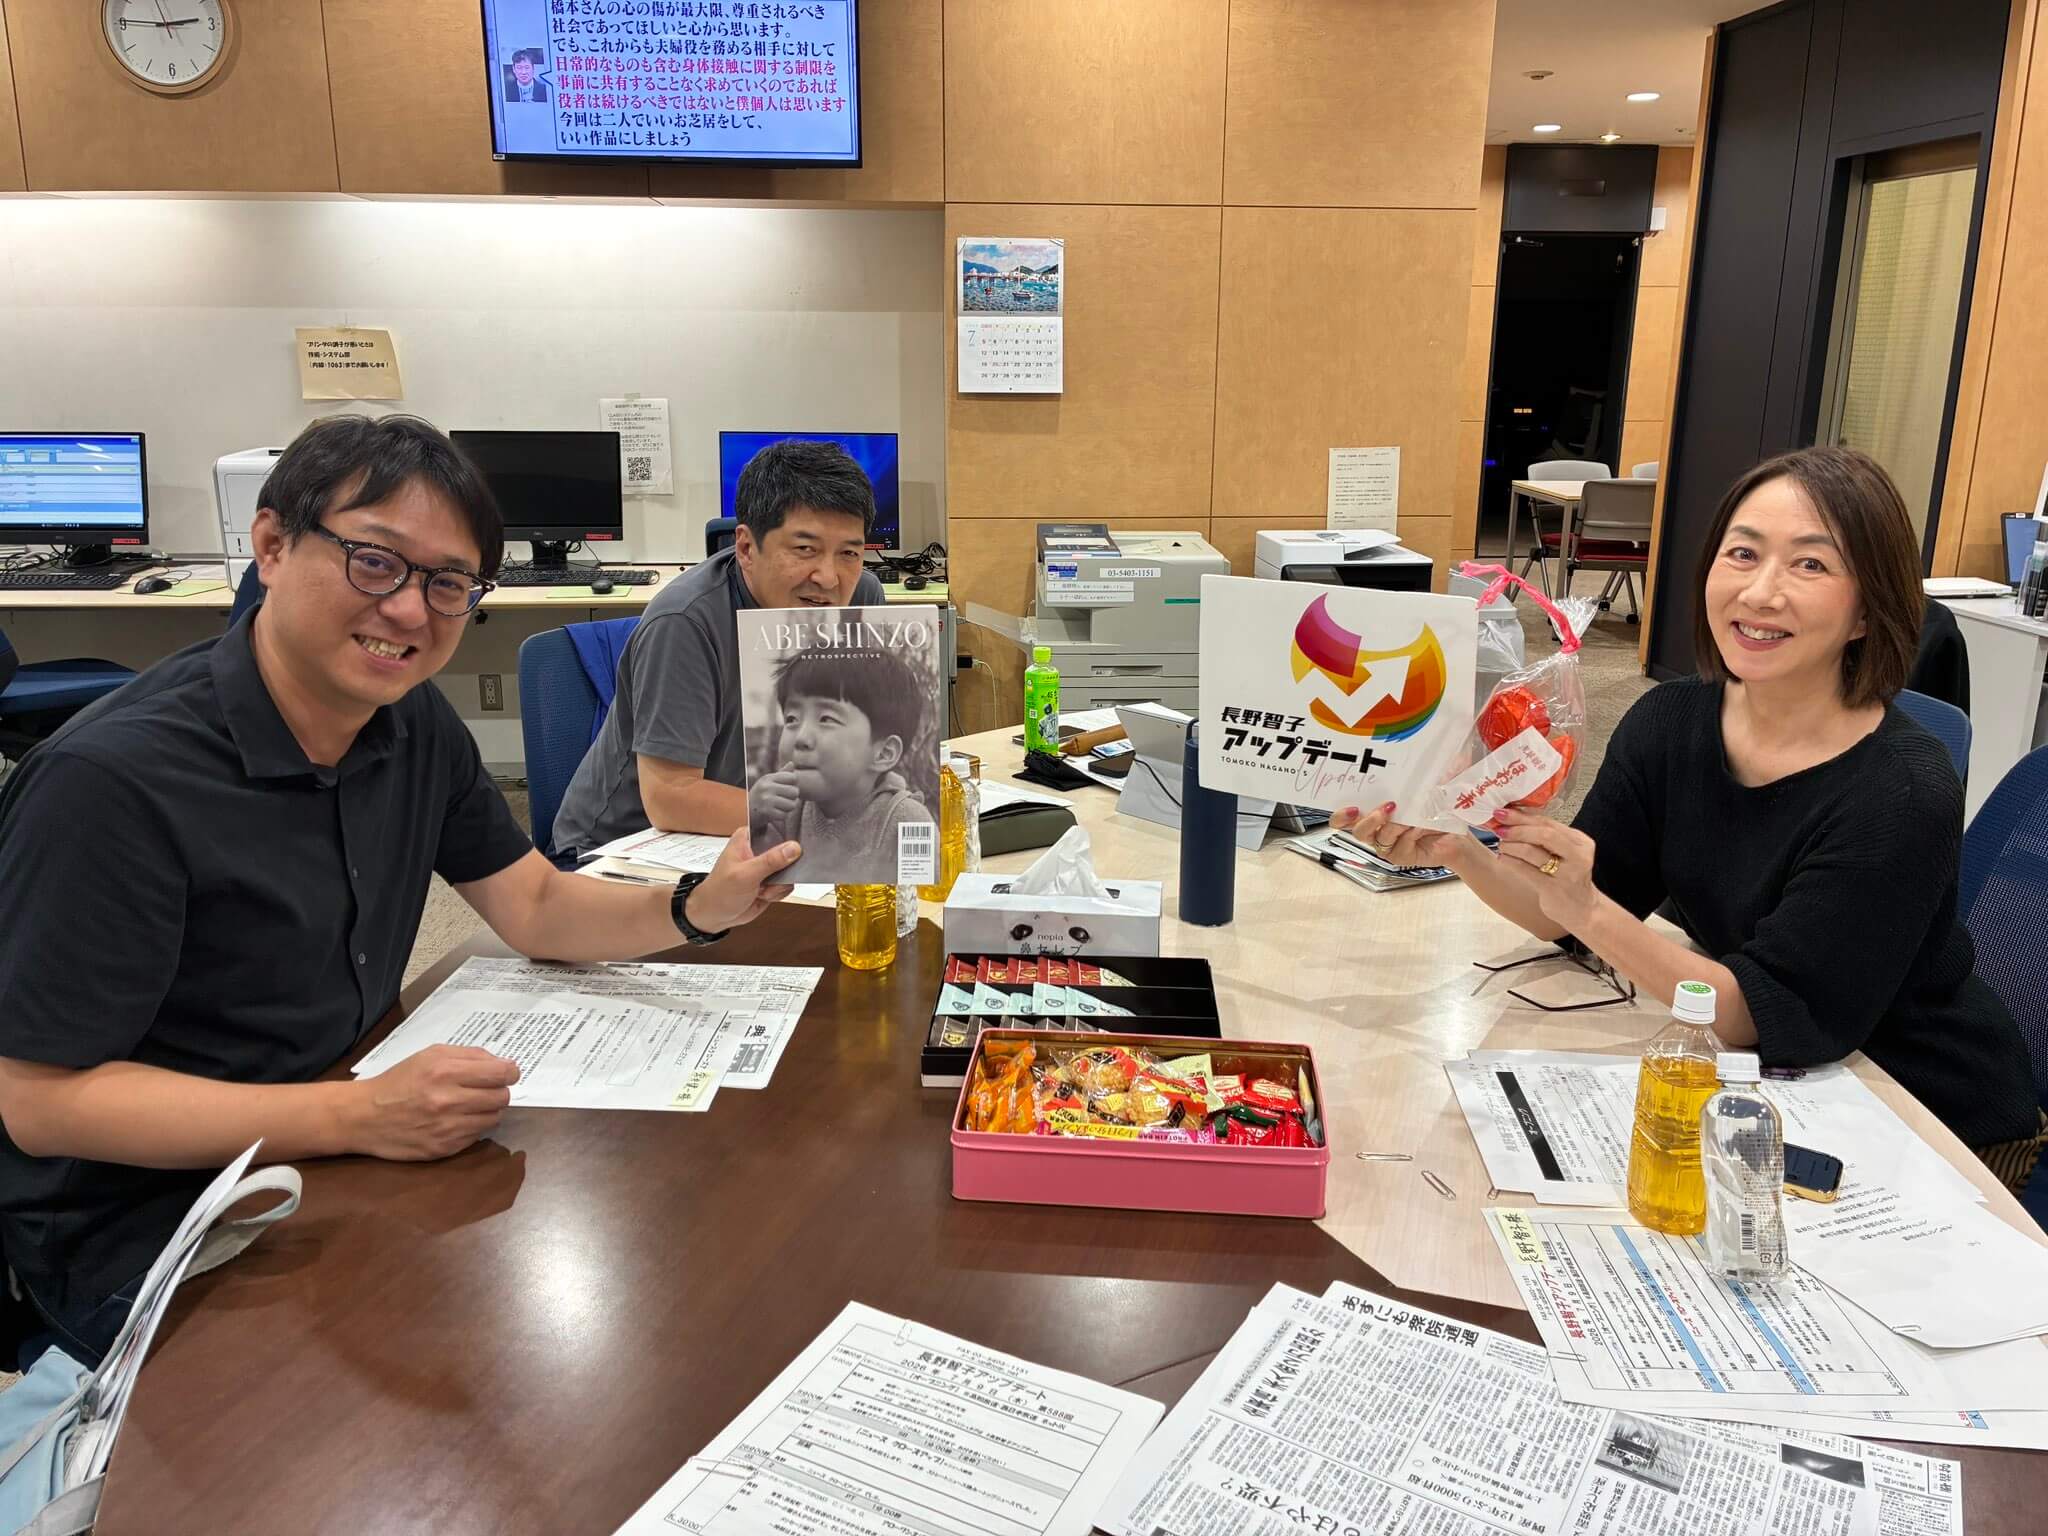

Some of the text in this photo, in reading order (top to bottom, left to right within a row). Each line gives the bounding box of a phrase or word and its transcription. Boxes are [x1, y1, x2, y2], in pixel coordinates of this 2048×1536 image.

[551, 1, 826, 18] 橋本さんの心の傷が最大限、尊重されるべき
[208, 17, 215, 31] 3
[552, 19, 791, 37] 社会であってほしいと心から思います。
[553, 38, 835, 57] でも、これからも夫婦役を務める相手に対して
[169, 63, 176, 77] 6
[556, 56, 836, 76] 日常的なものも含む身体接触に関する制限を
[557, 75, 837, 94] 事前に共有することなく求めていくのであれば
[559, 93, 846, 112] 役者は続けるべきではないと僕個人は思います
[560, 113, 762, 130] 今回は二人でいいお芝居をして、
[561, 131, 691, 147] いい作品にしましょう
[1107, 569, 1154, 577] 03-5403-1151
[754, 620, 927, 651] ABE SHINZO
[801, 652, 881, 660] RETROSPECTIVE
[1221, 706, 1305, 732] 長野智子
[1222, 727, 1387, 774] アップデート
[1221, 756, 1256, 768] TOMOKO
[1295, 755, 1377, 800] Update
[1037, 933, 1064, 941] nepia
[1541, 1264, 1586, 1340] 長野智子アップデー
[1342, 1294, 1480, 1349] あすにも衆院通過
[916, 1350, 1049, 1401] 長野智子アップデート
